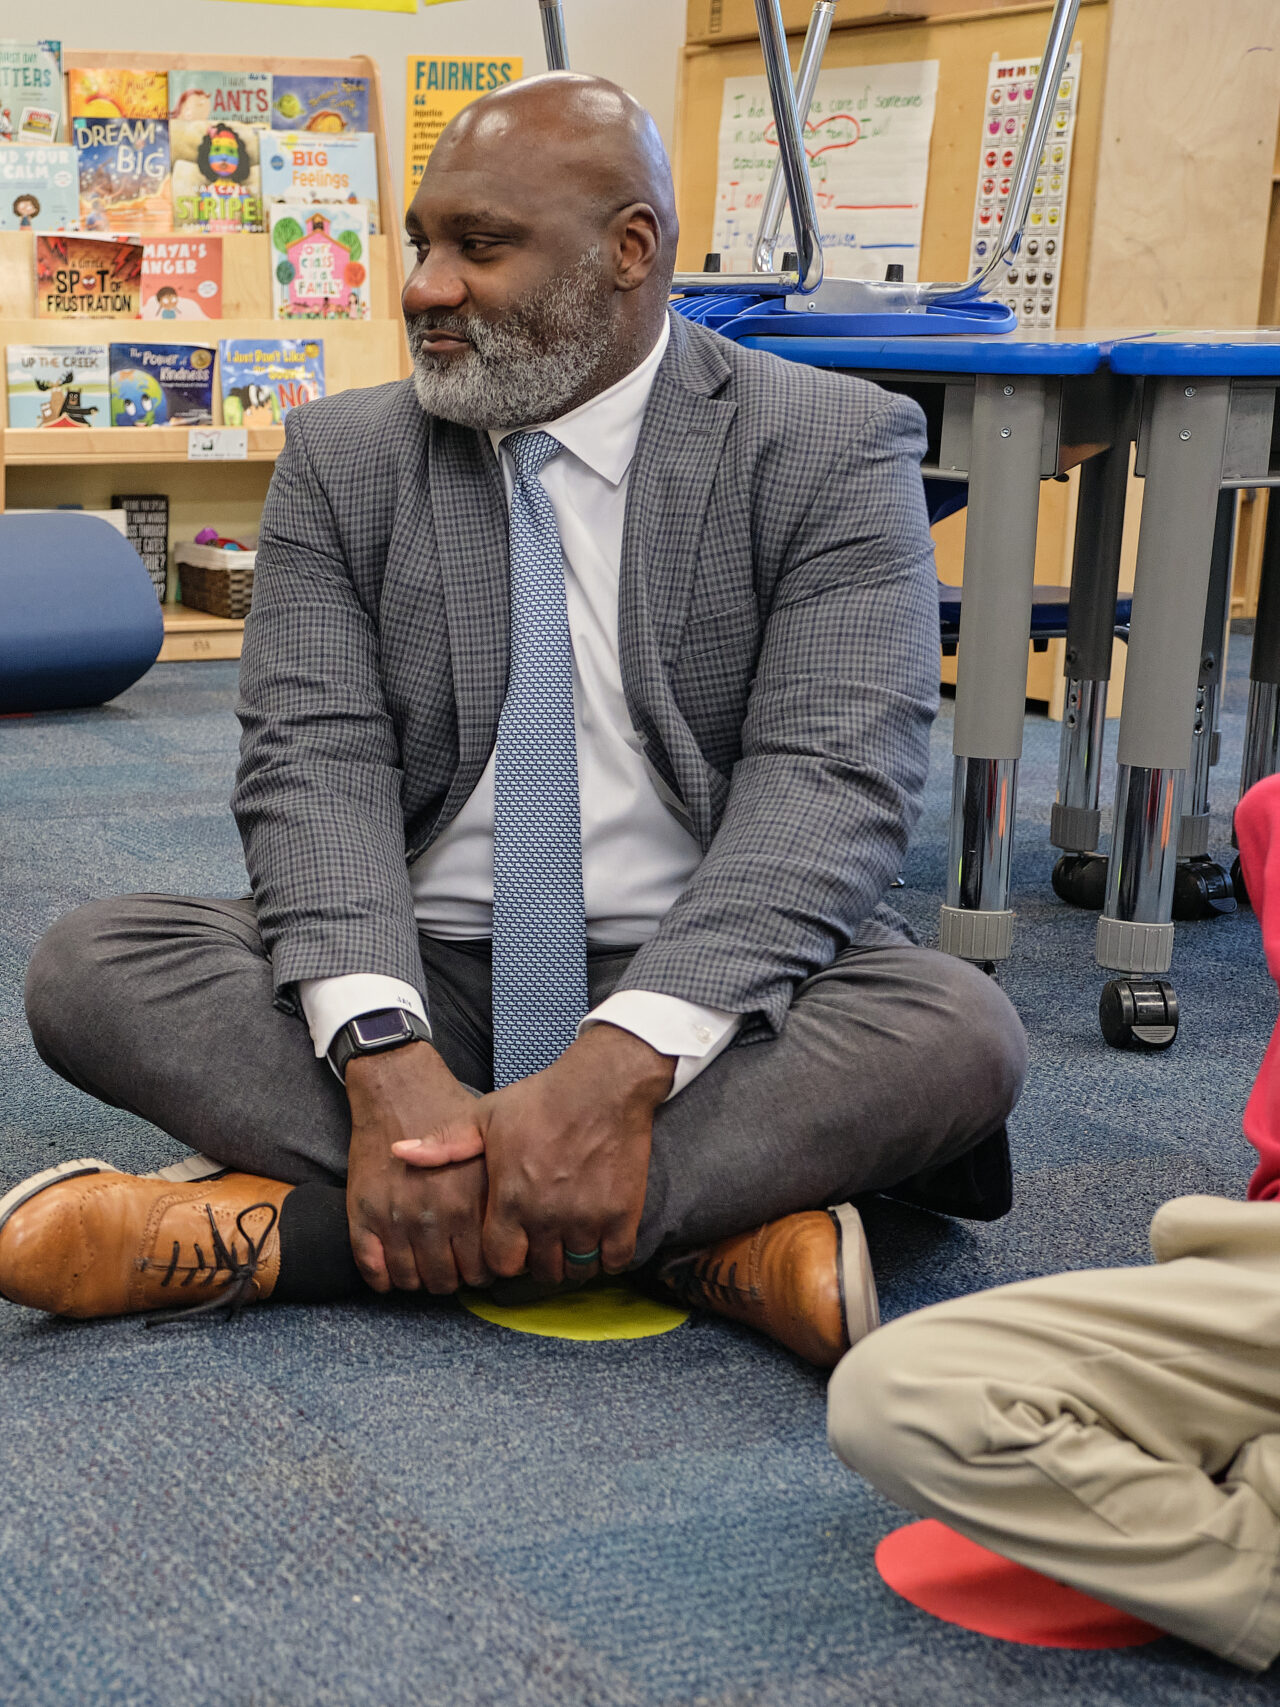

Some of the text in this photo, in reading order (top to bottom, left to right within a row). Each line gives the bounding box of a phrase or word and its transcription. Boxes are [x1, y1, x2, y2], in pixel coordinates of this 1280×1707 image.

[415, 61, 512, 91] FAIRNESS
[213, 88, 269, 113] ANTS
[77, 121, 156, 149] DREAM
[26, 150, 70, 164] YOUR
[116, 145, 165, 180] BIG
[292, 151, 328, 166] BIG
[3, 164, 50, 179] CALM
[292, 169, 349, 189] Feelings
[143, 243, 208, 259] MAYA'S
[141, 259, 198, 275] ANGER
[46, 293, 132, 312] FRUSTRATION
[21, 357, 99, 368] UP THE CREEK
[143, 350, 179, 366] Power
[159, 367, 210, 382] Kindness
